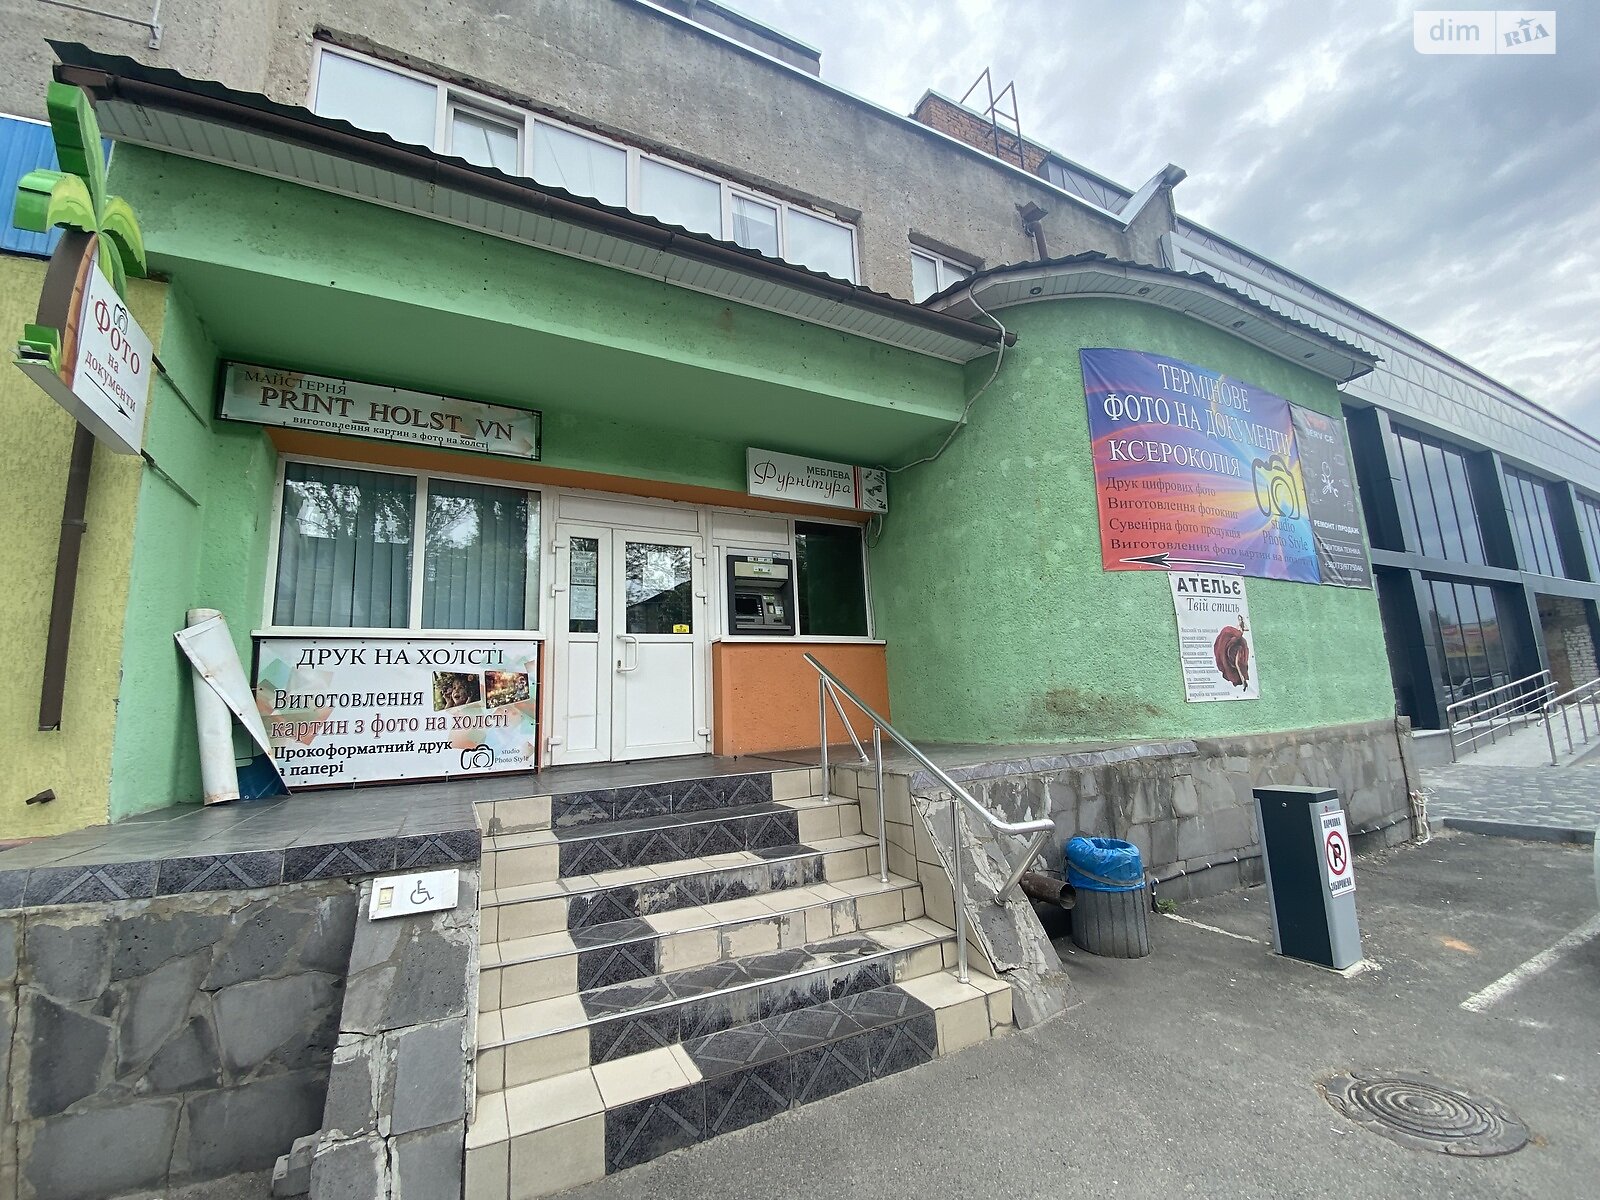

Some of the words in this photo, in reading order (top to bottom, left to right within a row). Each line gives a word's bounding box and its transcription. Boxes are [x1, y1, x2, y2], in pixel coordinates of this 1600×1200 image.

[108, 353, 119, 374] на
[85, 350, 136, 413] документи
[245, 370, 347, 396] МАЙСТЕРНЯ
[1157, 363, 1251, 413] ТЕРМІНОВЕ
[259, 386, 514, 441] PRINT_HOLST_VN
[292, 416, 370, 433] виготовлення
[373, 427, 409, 438] картин
[419, 431, 444, 442] фото
[446, 437, 457, 445] на
[1103, 393, 1170, 425] ФОТО
[1174, 400, 1202, 431] НА
[1204, 408, 1292, 457] ДОКУМЕНТИ
[1108, 439, 1242, 477] КСЕРОКОПІЯ
[753, 459, 851, 500] Фурнітура
[806, 465, 851, 481] МЕБЛЕВА
[1105, 476, 1138, 491] Друк
[1141, 478, 1194, 493] цифрових
[1195, 483, 1216, 497] фото
[1107, 497, 1196, 513] Виготовлення
[1197, 503, 1239, 520] фотокниг
[1109, 517, 1172, 533] Сувенірна
[1174, 520, 1199, 535] фото
[1200, 524, 1241, 540] продукція
[1271, 518, 1296, 534] studio
[1111, 538, 1210, 552] Виготовлення
[1212, 542, 1238, 556] фото
[1239, 549, 1271, 560] картин
[1262, 530, 1287, 547] Photo
[1288, 534, 1308, 553] Style
[1177, 577, 1241, 595] АТЕЛЬЄ
[1186, 597, 1208, 612] Твій
[1211, 600, 1240, 613] стиль
[296, 648, 366, 669] ДРУК
[373, 648, 411, 665] НА
[416, 648, 504, 665] ХОЛСТІ
[273, 688, 424, 710] Виготовлення
[271, 719, 349, 743] картин
[354, 718, 364, 735] з
[370, 713, 418, 738] фото
[424, 716, 446, 731] на
[451, 709, 509, 731] холсті
[418, 739, 453, 755] друк
[501, 747, 520, 755] studio
[289, 760, 344, 777] папері
[494, 756, 513, 764] Photo
